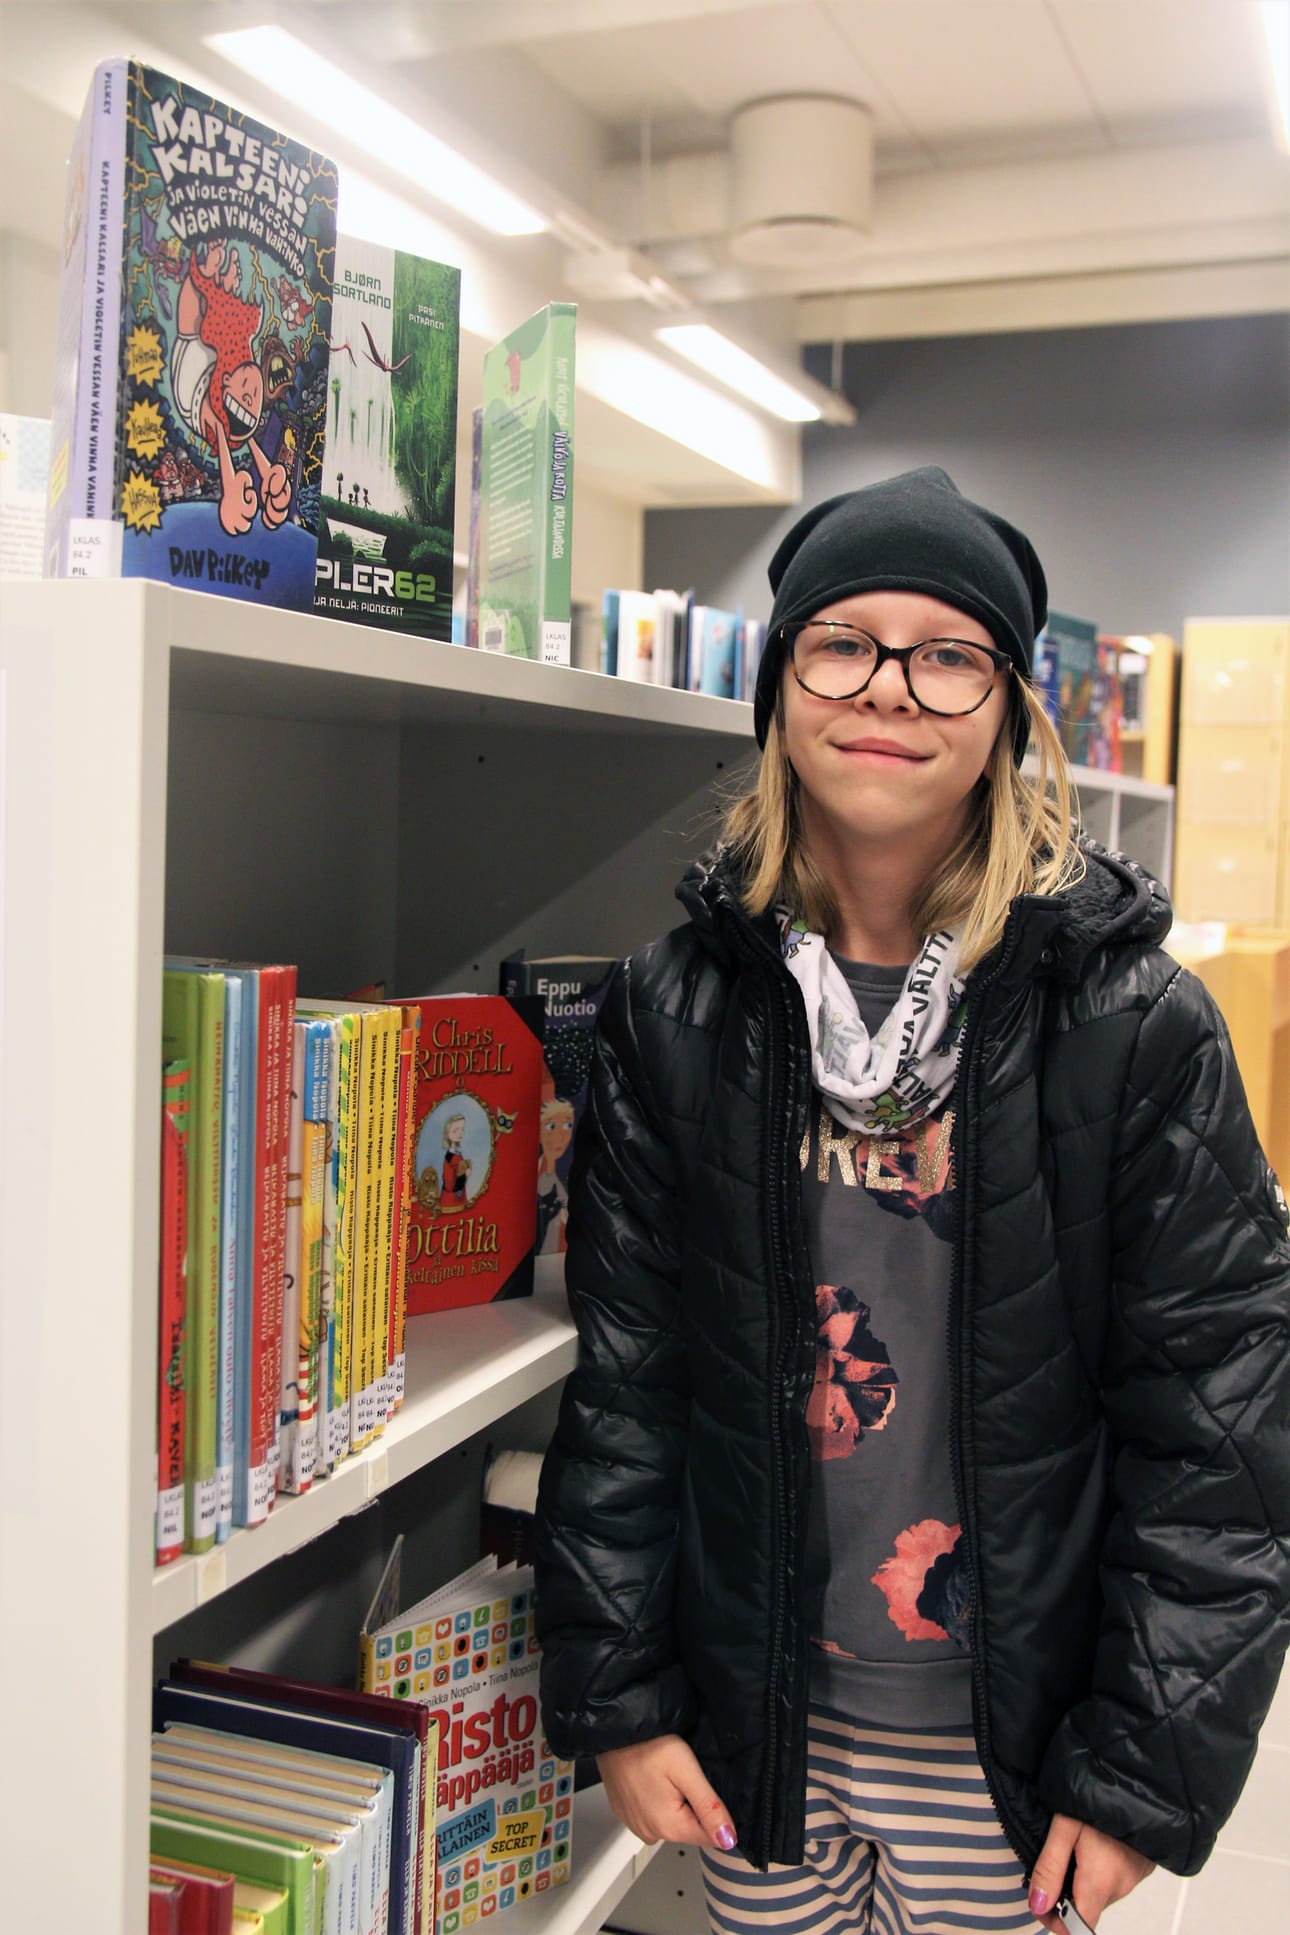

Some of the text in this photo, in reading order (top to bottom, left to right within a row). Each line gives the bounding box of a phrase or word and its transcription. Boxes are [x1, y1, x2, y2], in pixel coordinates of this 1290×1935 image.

[103, 72, 112, 115] PILKEY
[99, 161, 111, 221] KAPTEENI
[96, 224, 108, 276] KALSARI
[95, 279, 105, 294] JA
[344, 270, 382, 291] BJØRN
[333, 283, 392, 310] SORTLAND
[418, 304, 436, 316] PASI
[93, 297, 104, 348] VIOLETIN
[91, 354, 102, 397] VESSAN
[87, 436, 98, 472] VINHA
[551, 472, 567, 501] ROTTA
[72, 567, 88, 577] PIL
[168, 547, 205, 578] DAV
[361, 603, 405, 617] PIONEERIT
[545, 655, 560, 663] NIC
[537, 978, 581, 1001] Eppu
[432, 1016, 493, 1048] Chris
[313, 1037, 321, 1078] Sinikka
[416, 1043, 513, 1080] RIDDELL
[320, 1037, 330, 1119] Sinikka Nopola
[312, 1081, 320, 1120] Nopola
[800, 1110, 957, 1192] REV
[471, 1257, 499, 1275] kissa
[451, 1681, 481, 1701] Nopola
[488, 1671, 509, 1687] Tiina
[428, 1692, 538, 1772] Risto
[490, 1833, 537, 1854] SECRET
[505, 1820, 529, 1836] TOP
[381, 1888, 390, 1926] ELLA
